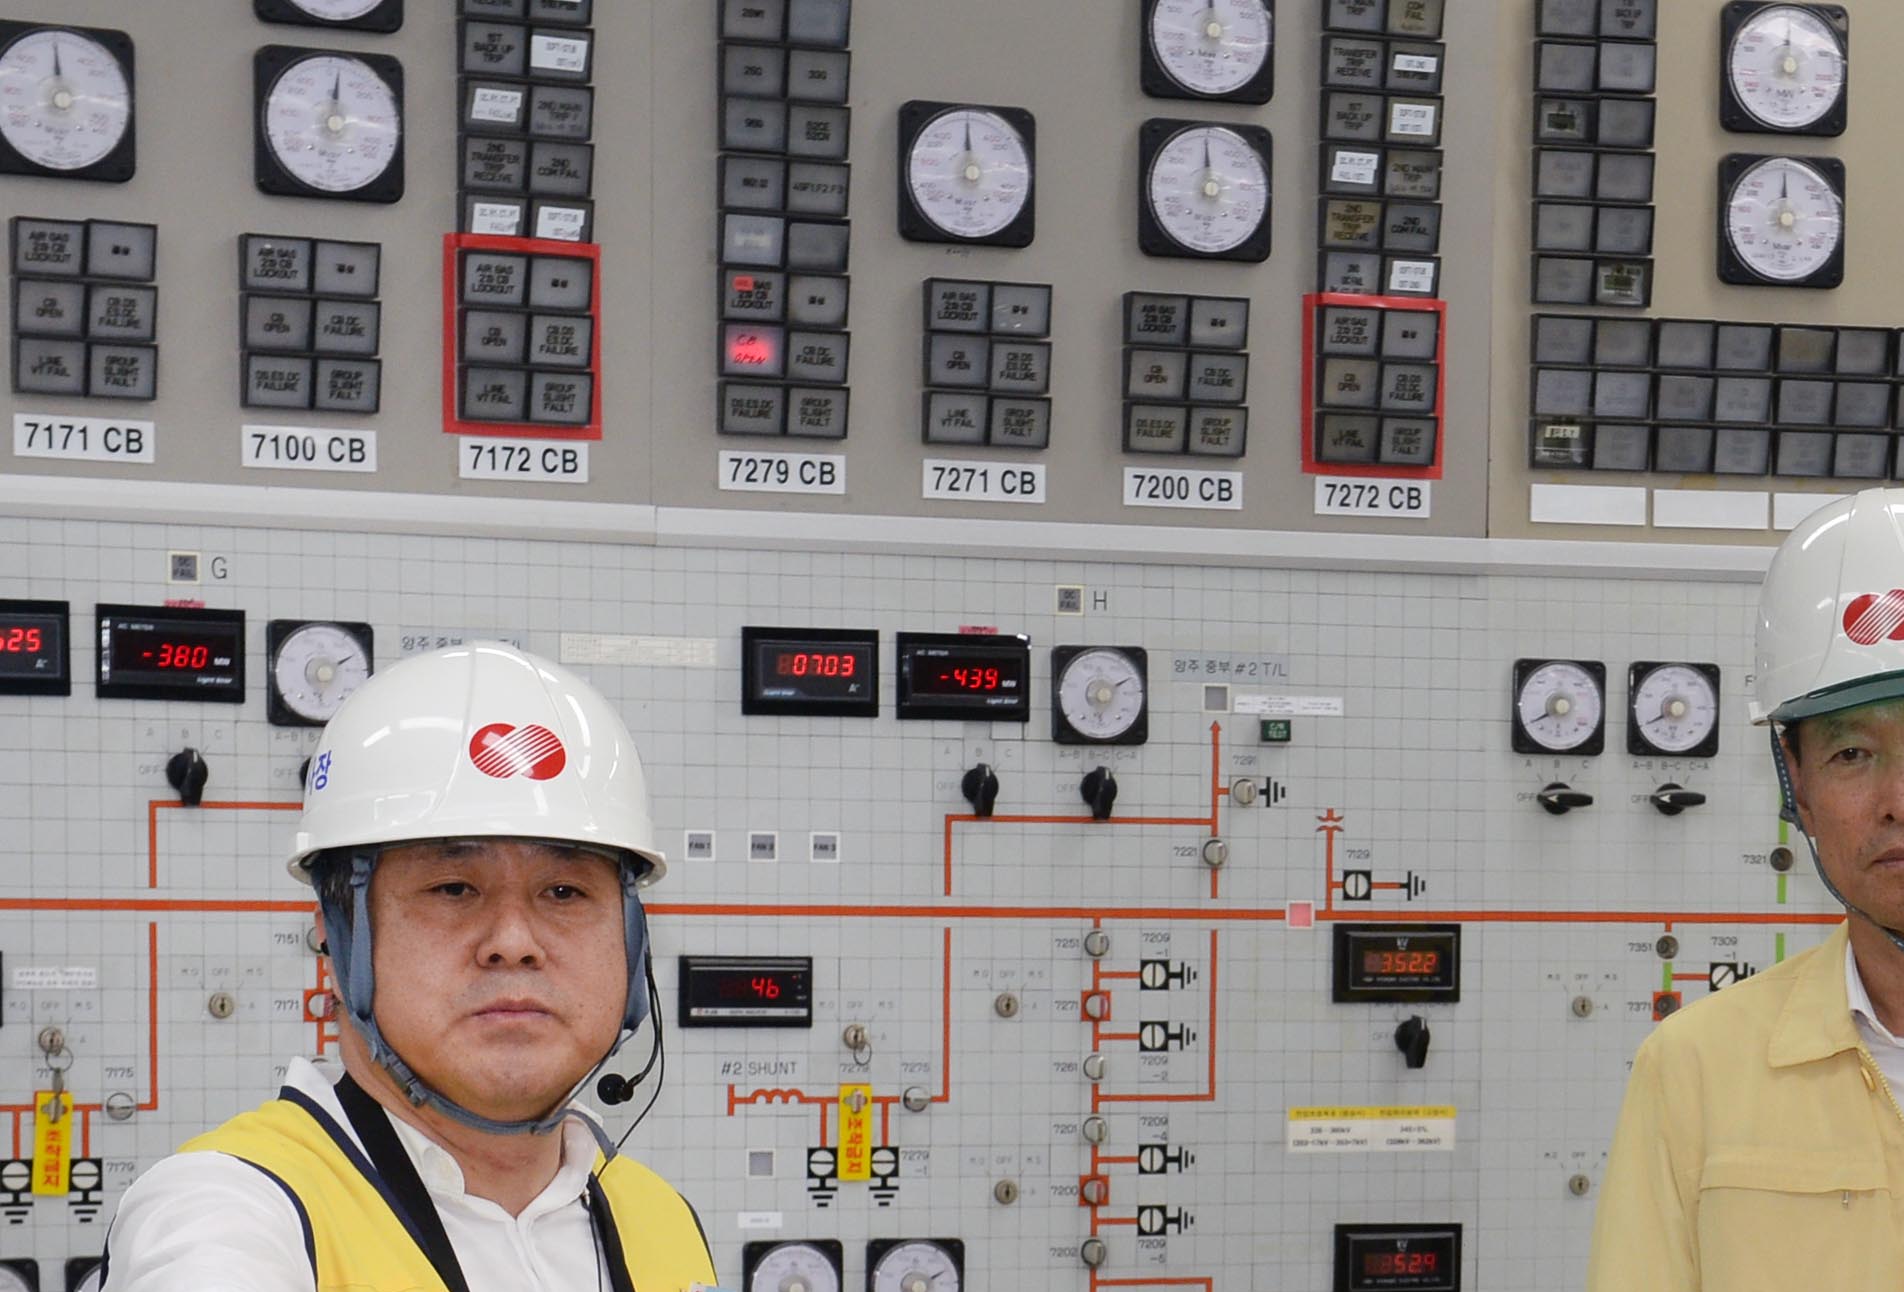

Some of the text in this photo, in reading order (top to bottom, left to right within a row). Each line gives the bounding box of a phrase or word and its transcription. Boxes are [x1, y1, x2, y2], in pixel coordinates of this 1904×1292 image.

[24, 423, 143, 453] 7171 CB
[251, 434, 366, 463] 7100 CB
[470, 445, 578, 473] 7172 CB
[729, 458, 836, 485] 7279 CB
[932, 467, 1036, 495] 7271 CB
[1132, 474, 1233, 502] 7200 CB
[1325, 484, 1422, 511] 7272 CB
[211, 557, 228, 580] G
[1093, 590, 1108, 611] H
[791, 654, 855, 676] 0703
[1262, 663, 1288, 678] T/L
[1742, 854, 1767, 865] 7321
[274, 934, 300, 944] 7151
[1711, 937, 1737, 947] 7309
[1628, 942, 1653, 952] 7351
[274, 1001, 300, 1011] 7171
[1054, 1001, 1079, 1010] 7271
[1628, 1002, 1652, 1012] 7371
[105, 1068, 134, 1078] 7175
[748, 1062, 798, 1076] SHUNT
[1050, 1186, 1078, 1196] 7200
